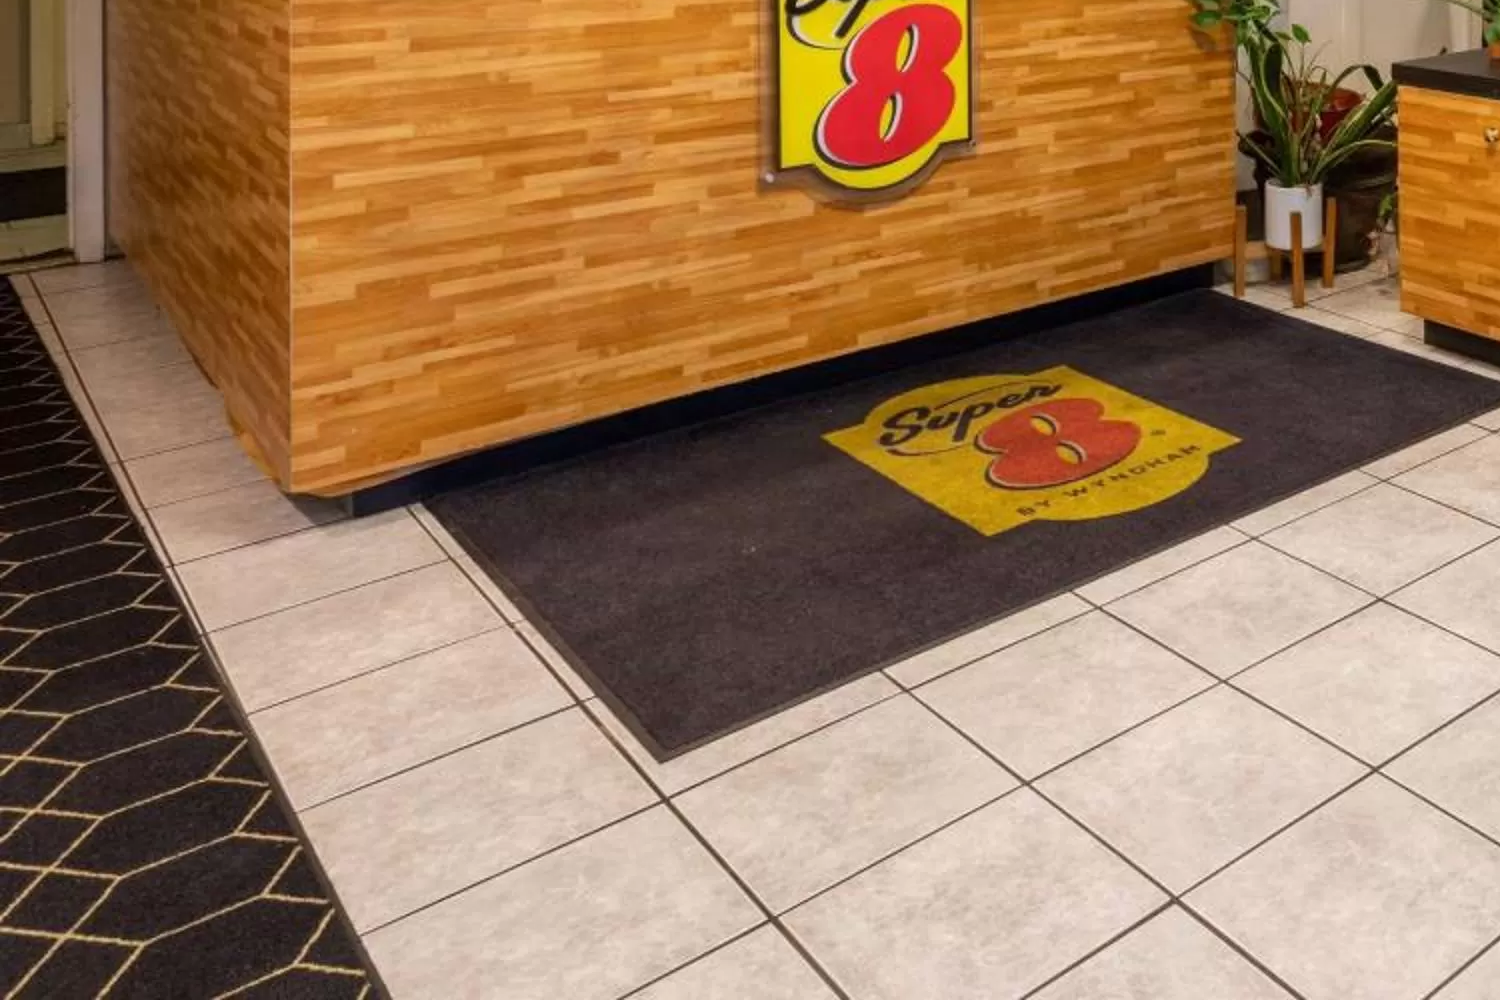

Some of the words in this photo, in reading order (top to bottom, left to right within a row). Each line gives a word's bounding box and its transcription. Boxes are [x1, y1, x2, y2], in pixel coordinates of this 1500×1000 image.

[813, 3, 963, 171] 8
[879, 384, 1063, 447] Super
[974, 397, 1142, 489] 8
[1015, 499, 1051, 516] BY
[1063, 444, 1201, 497] WYNDHAM
